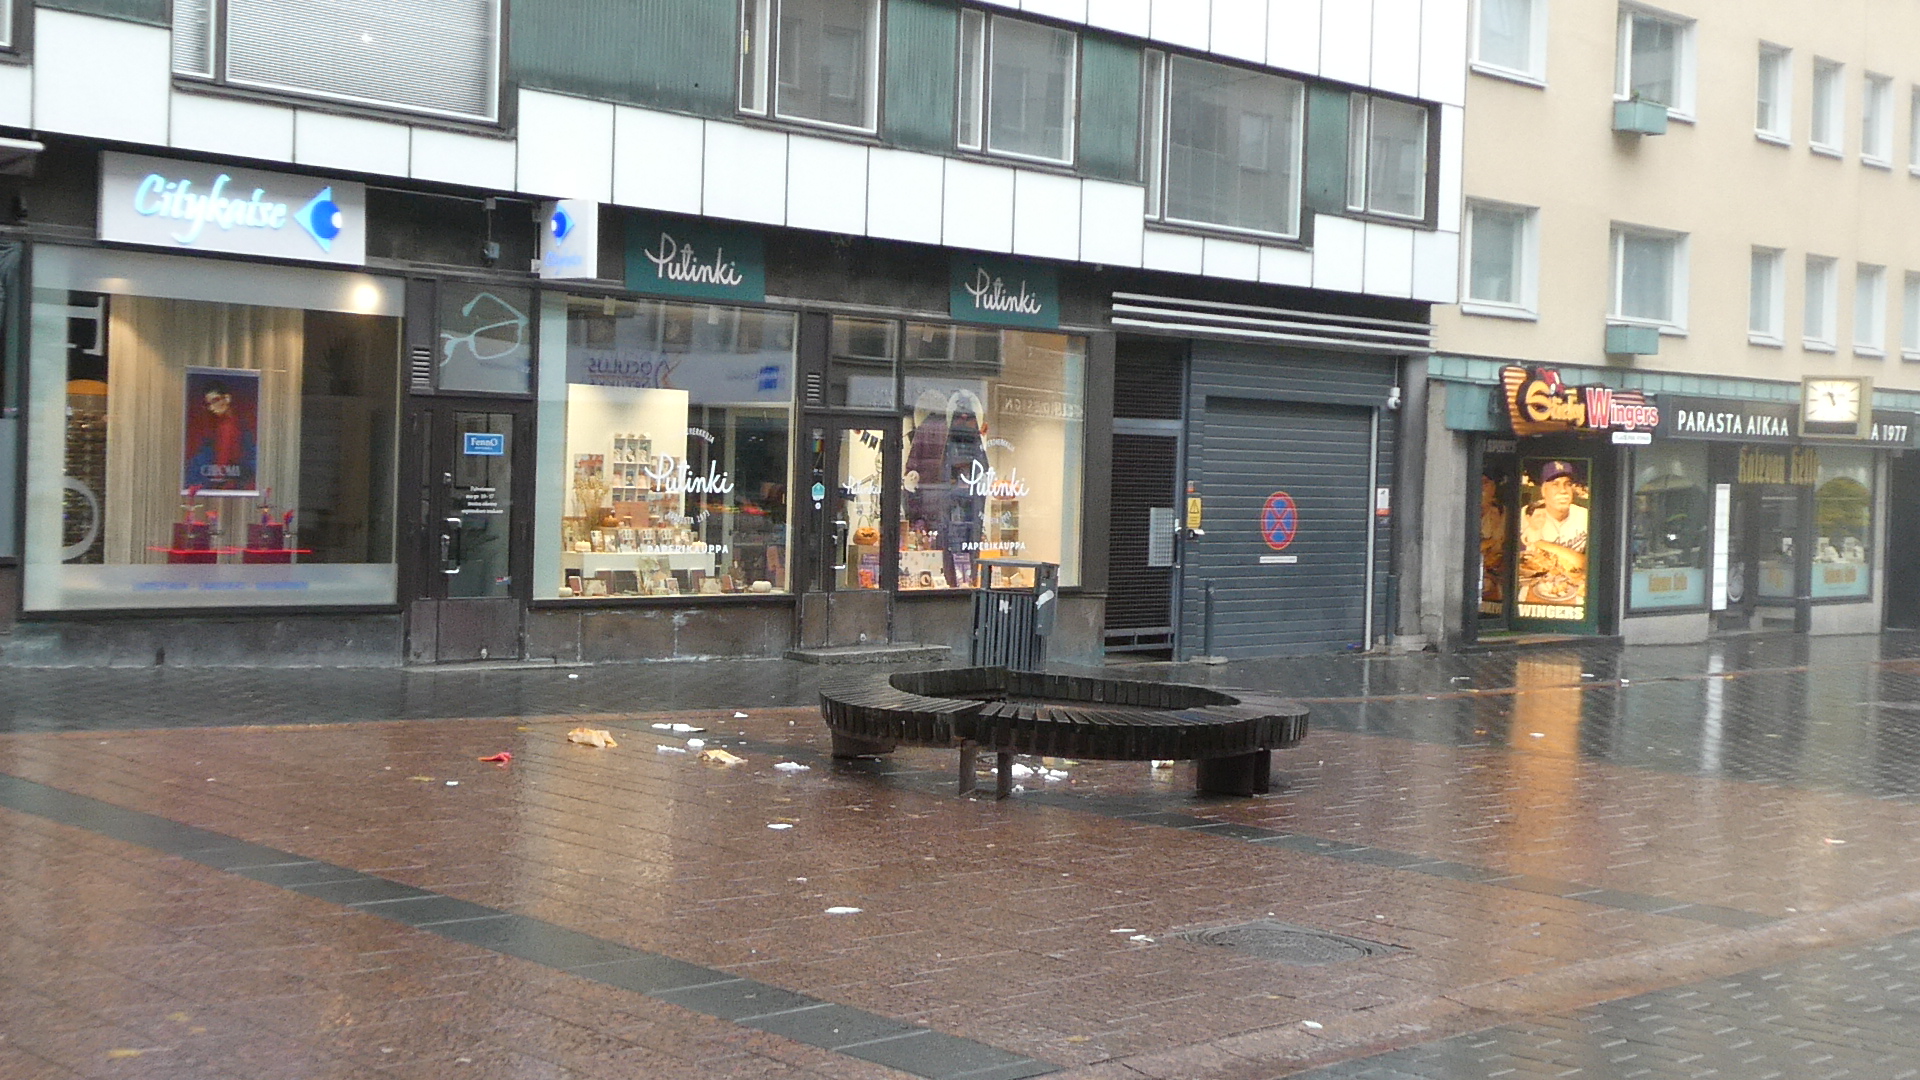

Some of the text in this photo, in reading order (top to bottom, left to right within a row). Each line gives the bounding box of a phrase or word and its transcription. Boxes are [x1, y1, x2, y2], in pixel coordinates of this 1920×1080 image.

[135, 174, 287, 243] Citykatse
[644, 232, 743, 286] Putinki
[965, 267, 1042, 314] Putinki
[1525, 380, 1659, 430] Sticky Wingers
[1678, 410, 1907, 441] PARASTA AIKAA A 1977
[644, 452, 734, 494] Putinki
[960, 459, 1030, 497] Putinki
[647, 544, 729, 554] PAPERIKAUPPA
[961, 541, 1026, 551] PAPERIKAUPPA
[1518, 604, 1584, 620] WINGERS
